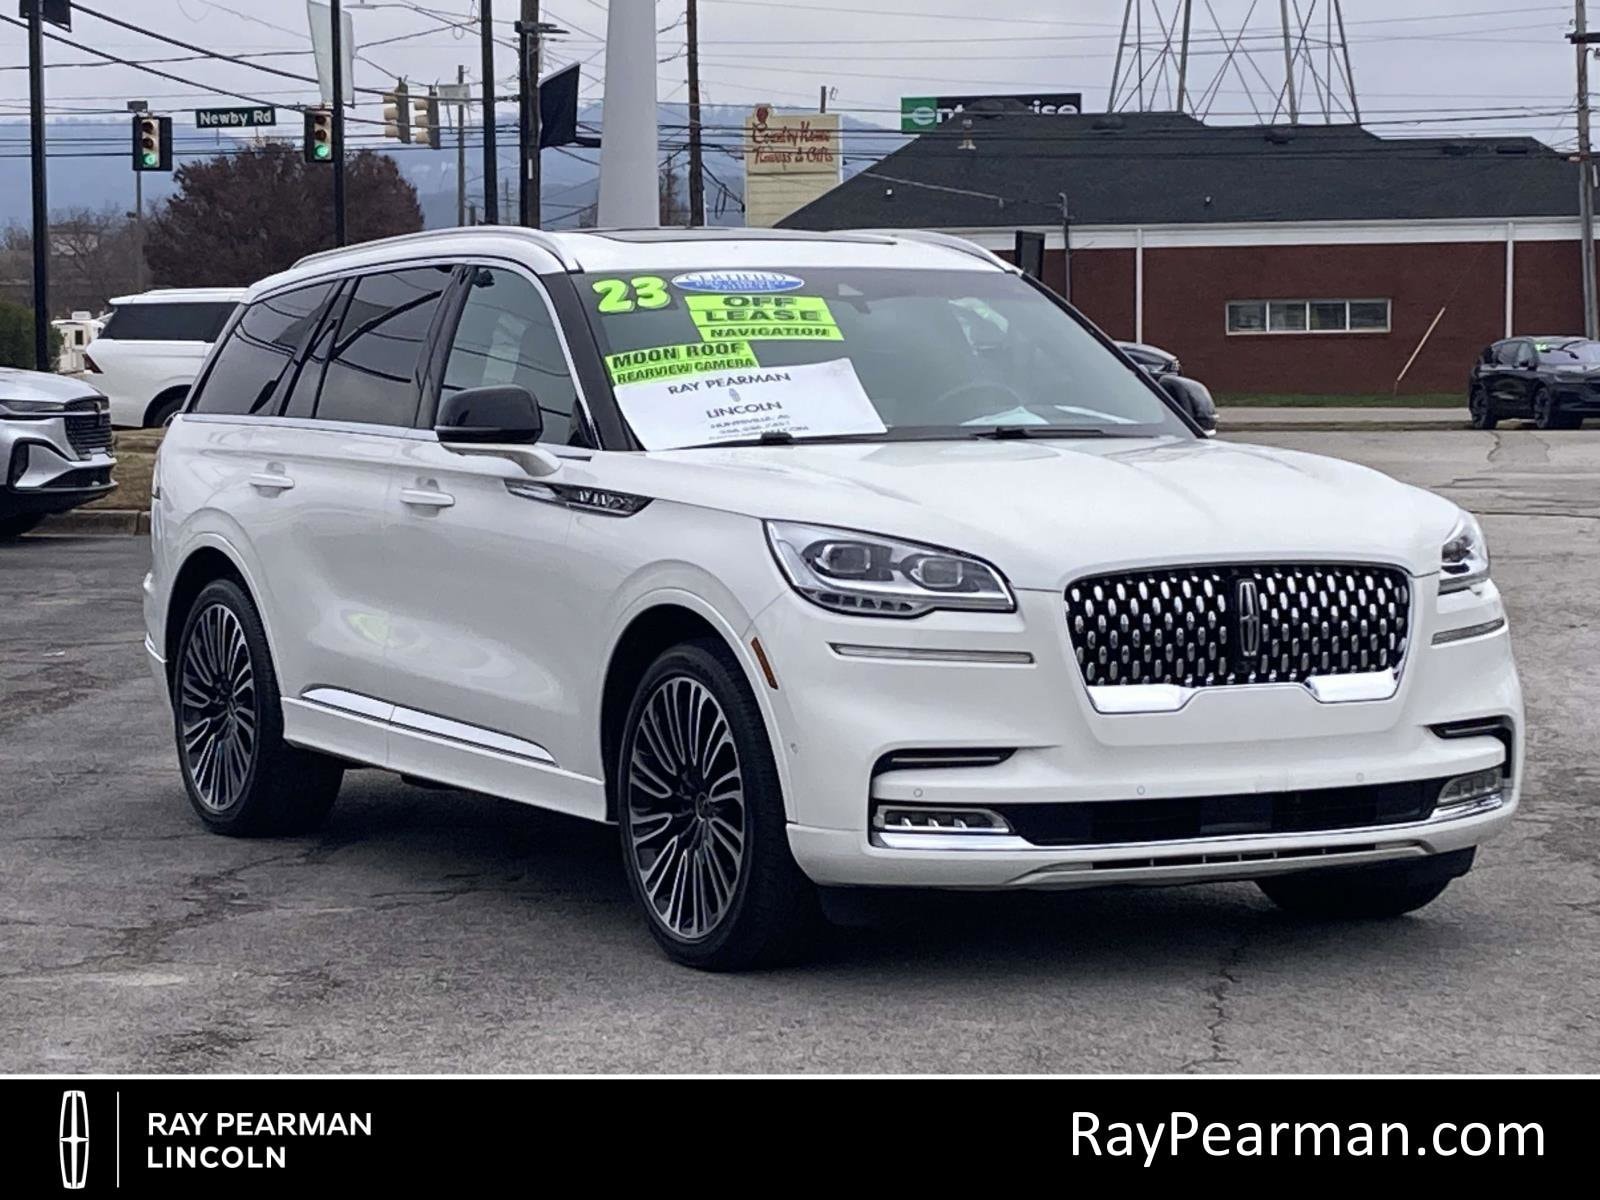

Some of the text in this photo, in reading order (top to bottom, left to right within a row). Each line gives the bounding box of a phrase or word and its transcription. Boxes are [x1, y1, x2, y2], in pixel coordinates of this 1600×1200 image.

[200, 110, 272, 127] Newby Rd
[592, 276, 671, 313] 23
[722, 296, 798, 307] OFF
[705, 310, 822, 322] LEASE
[710, 327, 830, 338] NAVIGATION
[613, 342, 742, 369] MOON ROOF
[616, 358, 756, 384] REARVIEW CAMERA
[668, 373, 792, 395] RAY PEARMAN
[706, 401, 783, 419] LINCOLN
